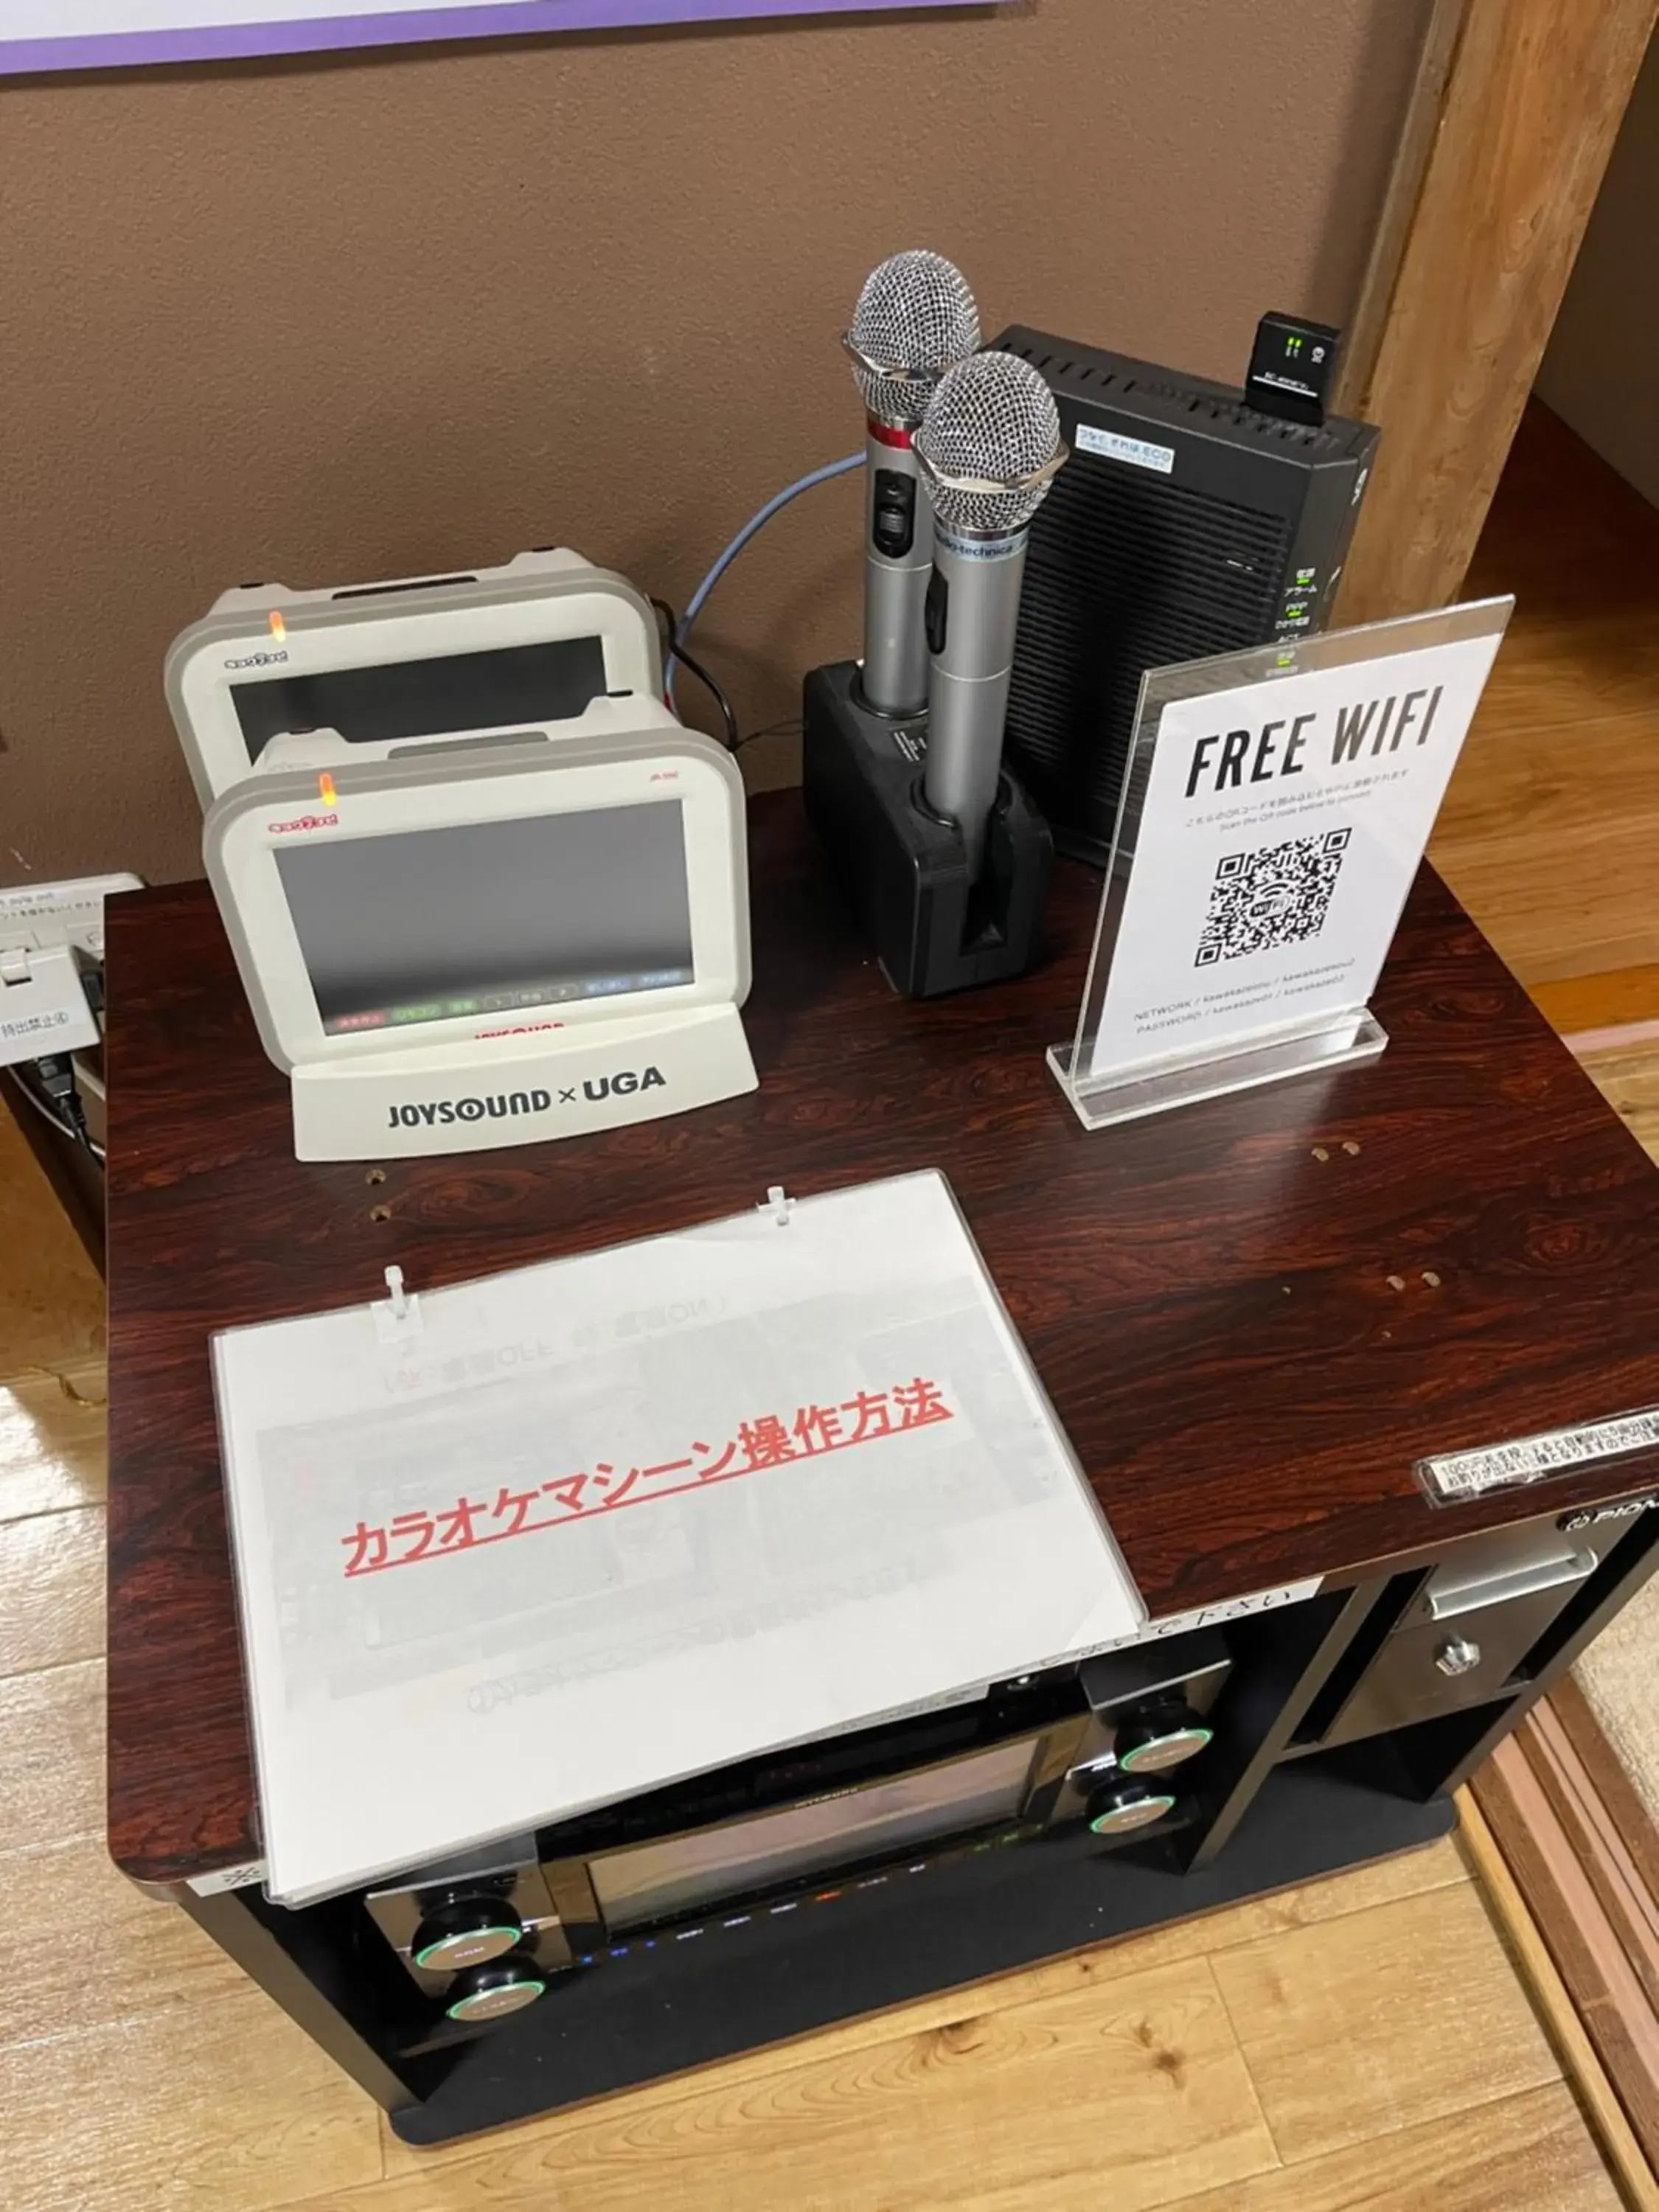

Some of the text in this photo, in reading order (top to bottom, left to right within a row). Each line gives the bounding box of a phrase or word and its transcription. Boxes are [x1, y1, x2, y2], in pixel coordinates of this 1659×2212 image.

[1184, 684, 1444, 799] FREE WIFI
[1135, 999, 1192, 1021] NETWORK
[1136, 1011, 1203, 1034] PASSWORD
[388, 1088, 552, 1128] JOYSOUND
[582, 1066, 667, 1102] UGA
[341, 1377, 954, 1575] カラオケマシーン操作方法
